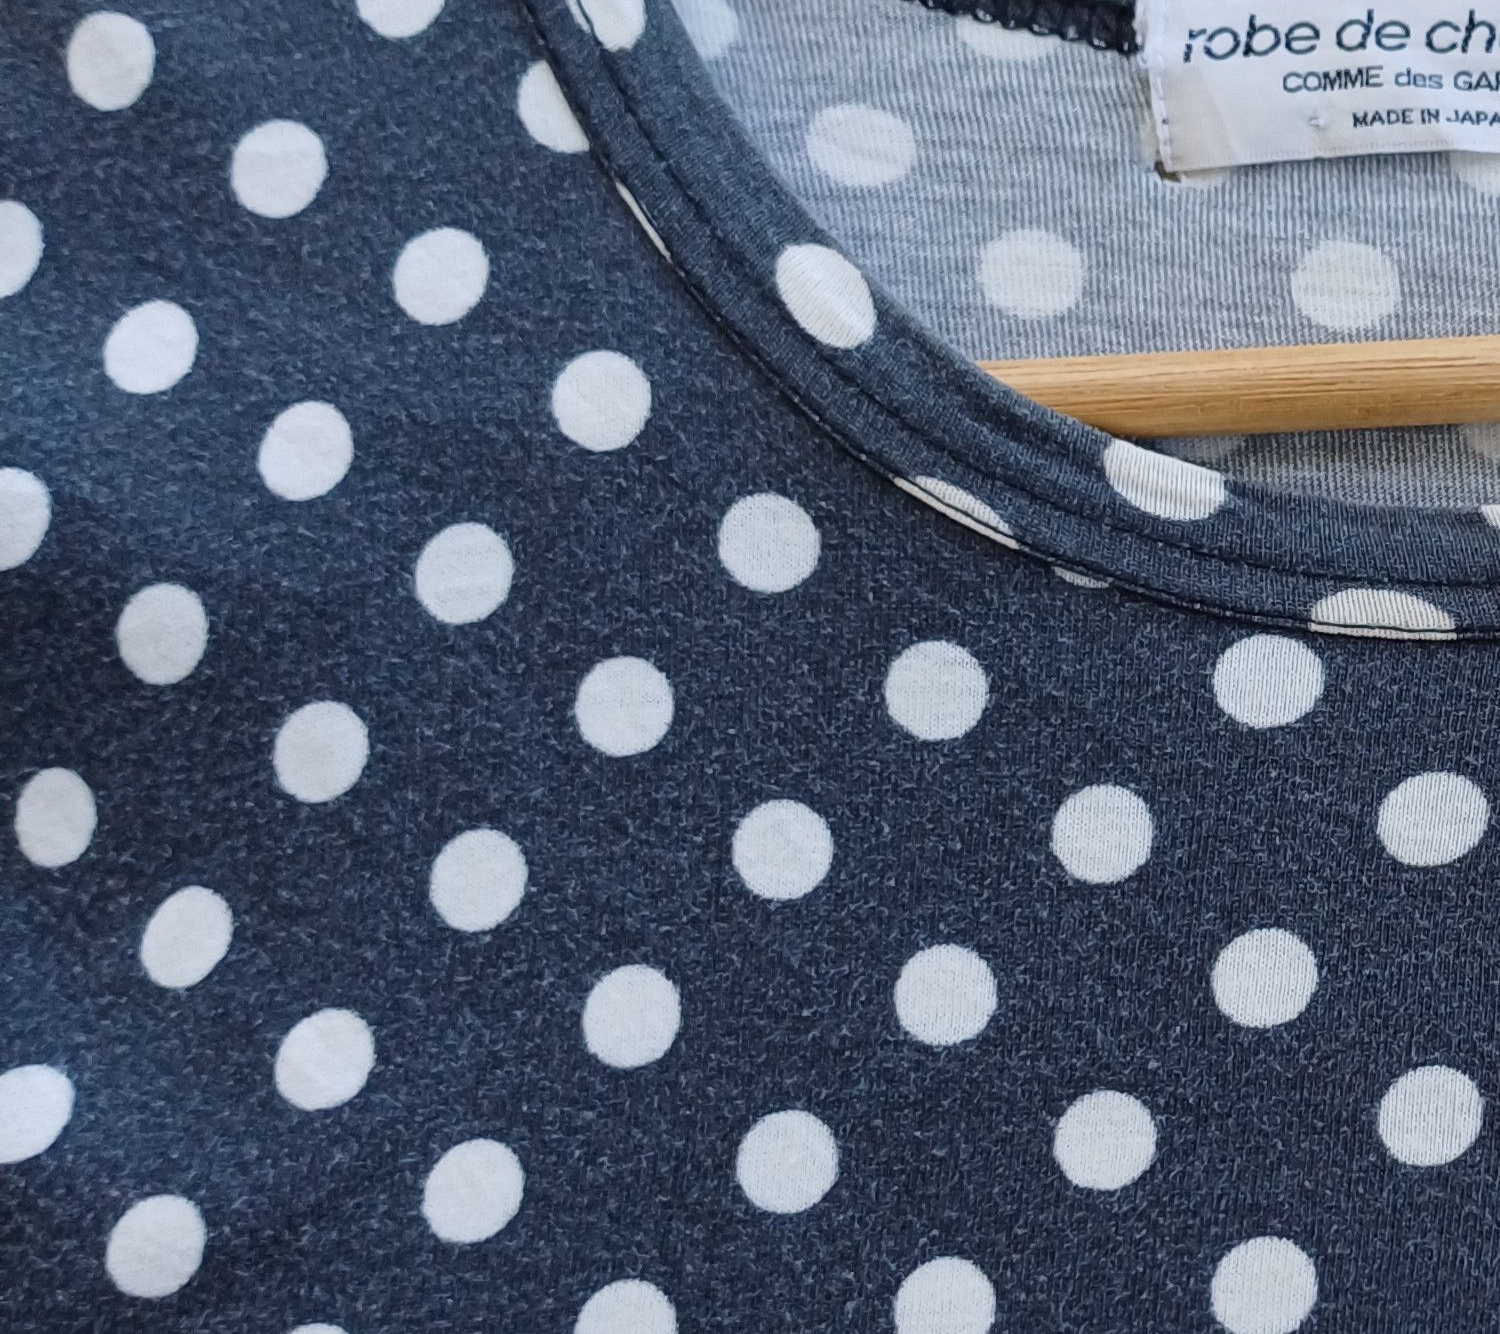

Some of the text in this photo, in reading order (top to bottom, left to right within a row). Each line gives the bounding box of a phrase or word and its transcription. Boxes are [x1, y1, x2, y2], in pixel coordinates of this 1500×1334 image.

[1182, 13, 1321, 64] robe
[1334, 8, 1412, 53] de
[1282, 64, 1385, 94] COMME
[1393, 67, 1444, 90] des
[1351, 107, 1415, 129] MADE
[1419, 107, 1441, 126] IN
